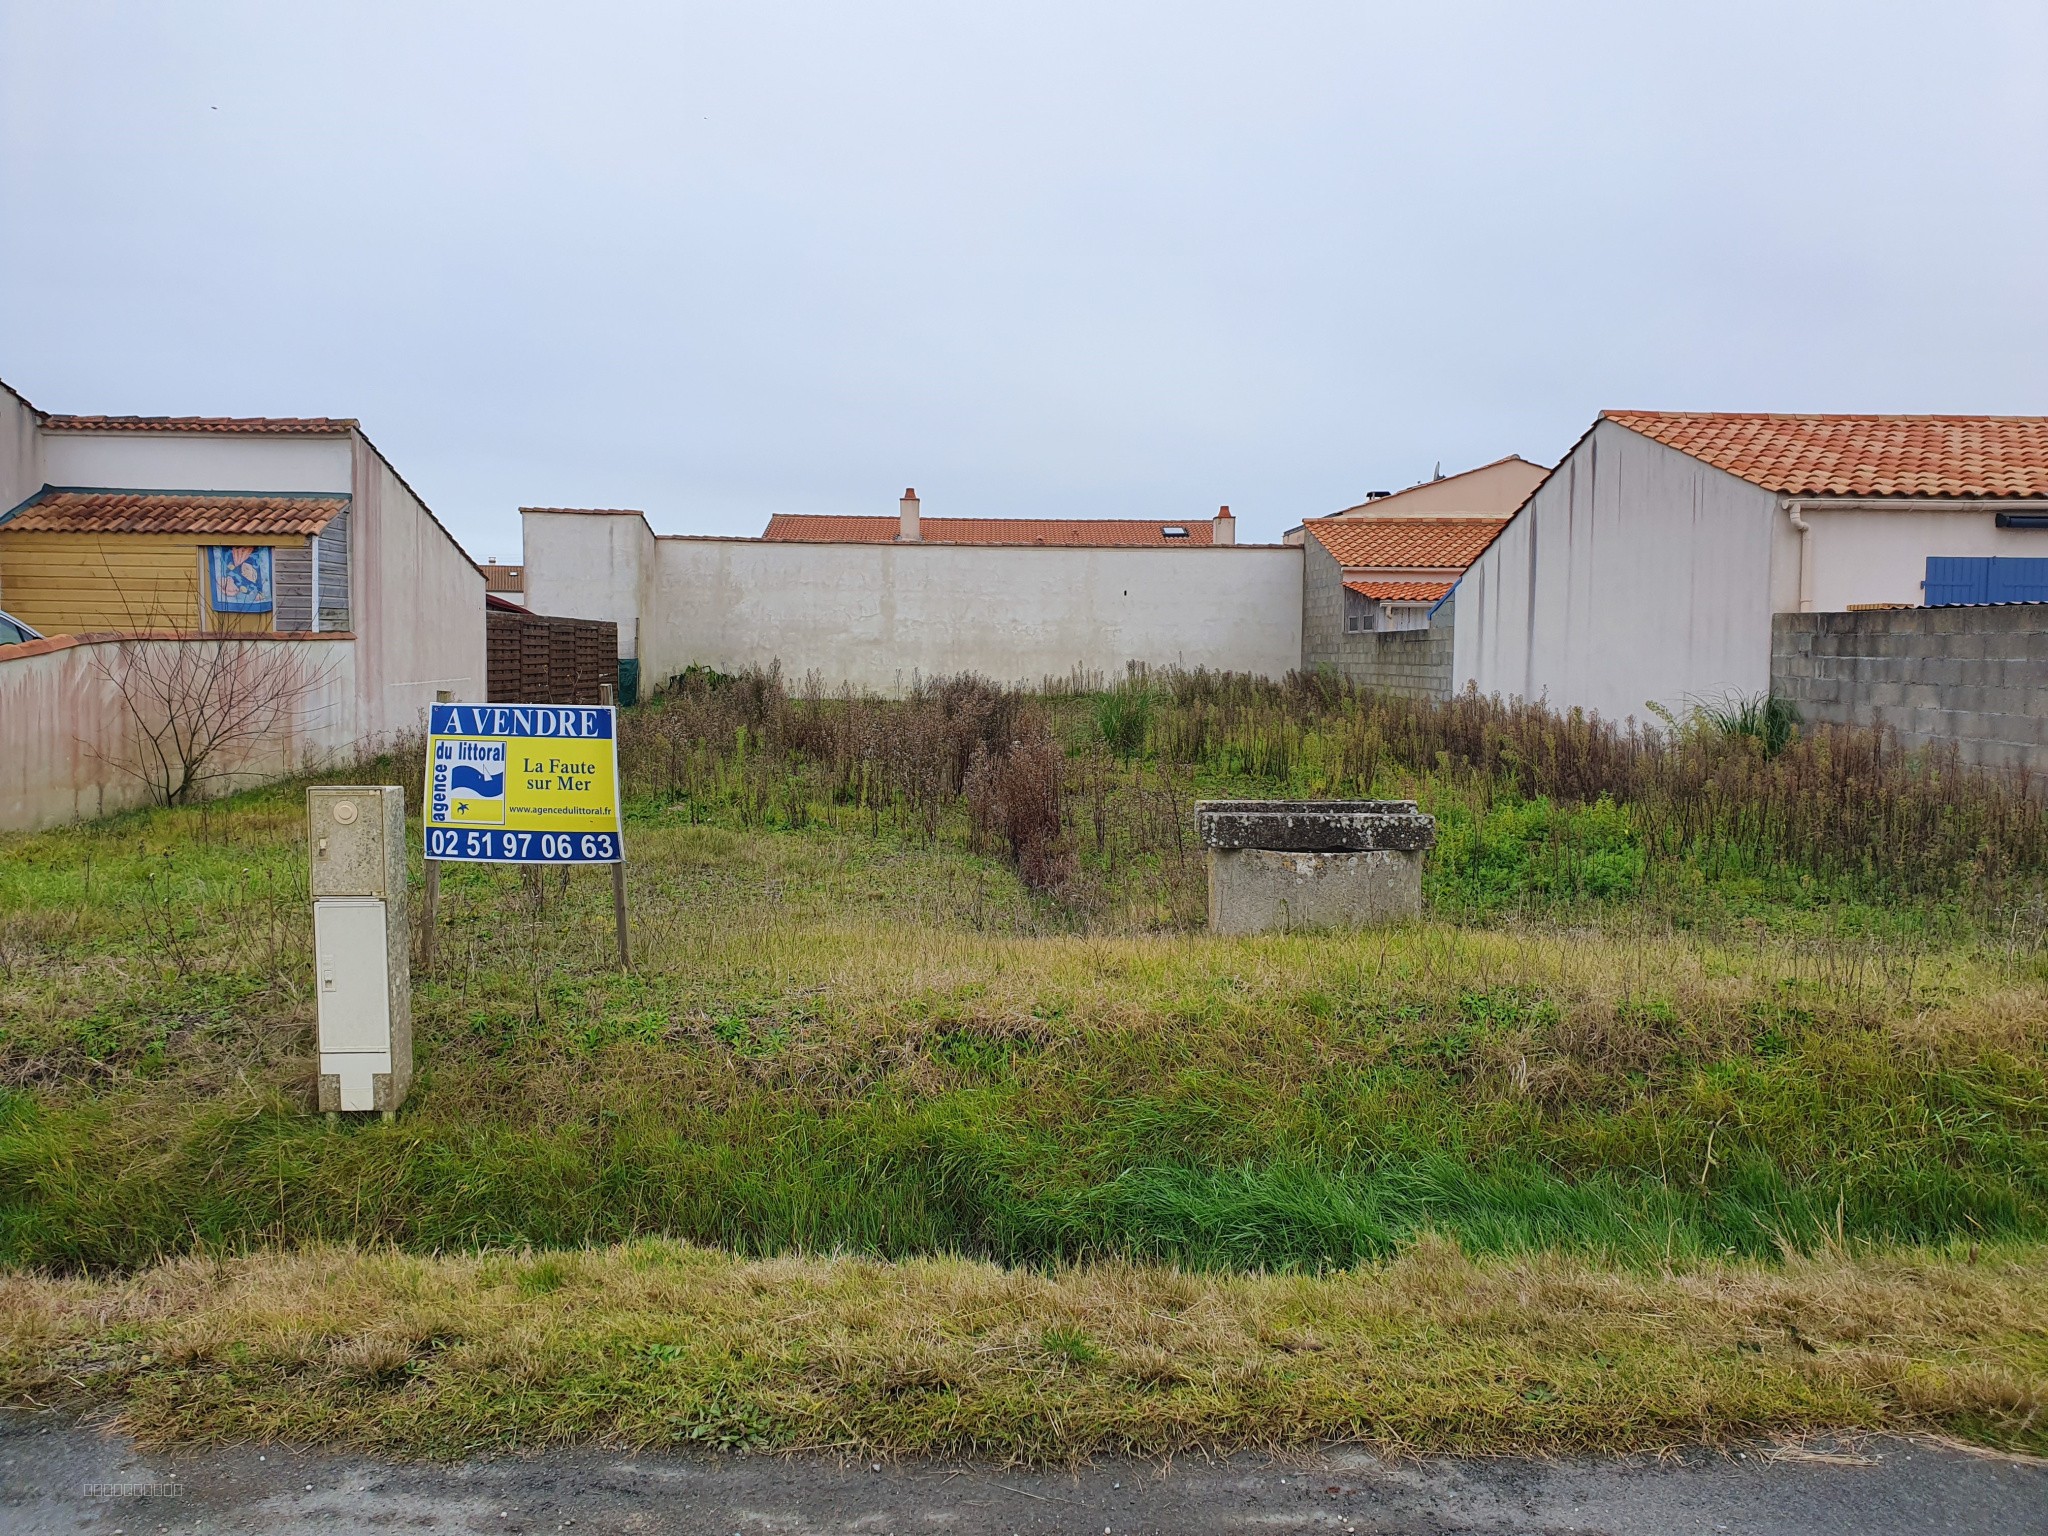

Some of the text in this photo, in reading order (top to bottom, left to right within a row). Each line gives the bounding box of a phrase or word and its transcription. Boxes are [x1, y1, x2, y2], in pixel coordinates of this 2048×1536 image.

[443, 708, 598, 737] A VENDRE
[436, 742, 505, 761] du littoral
[523, 758, 595, 773] La Faute
[433, 764, 448, 821] agence
[527, 777, 591, 791] sur Mer
[509, 805, 611, 815] www.agencedulittoral.fr
[432, 830, 612, 859] 02 51 97 06 63
